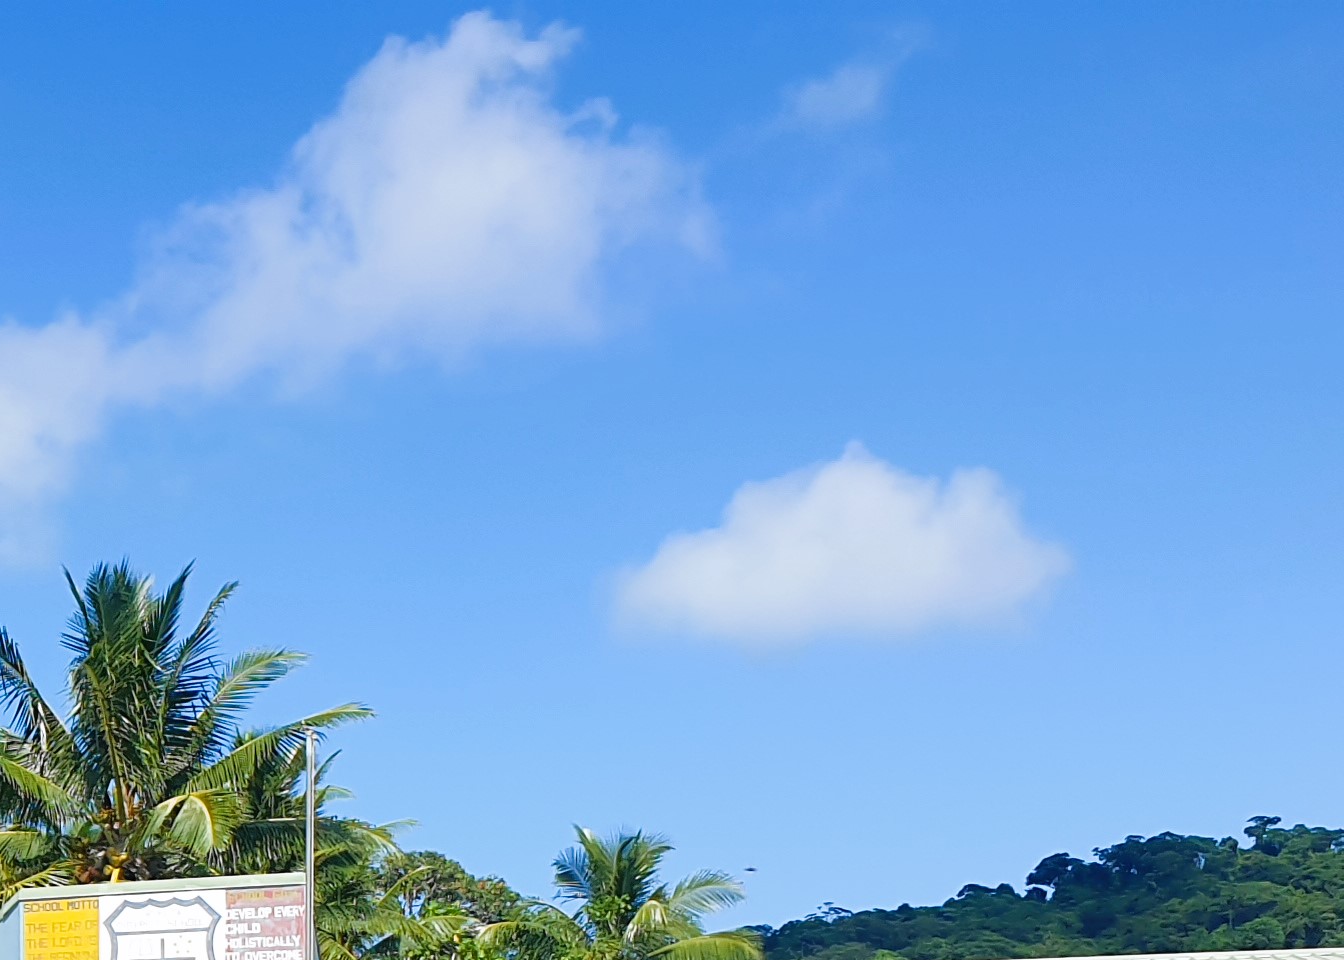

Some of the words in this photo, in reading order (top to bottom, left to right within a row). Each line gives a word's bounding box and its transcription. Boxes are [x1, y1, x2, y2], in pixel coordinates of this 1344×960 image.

[23, 902, 64, 913] SCHOOL
[67, 899, 99, 910] MOTTO
[225, 907, 272, 920] DEVELOP
[274, 905, 305, 918] EVERY
[25, 923, 48, 934] THE
[52, 921, 81, 933] FEAR
[225, 922, 261, 934] CHILD
[225, 935, 301, 949] HOLISTICALLY
